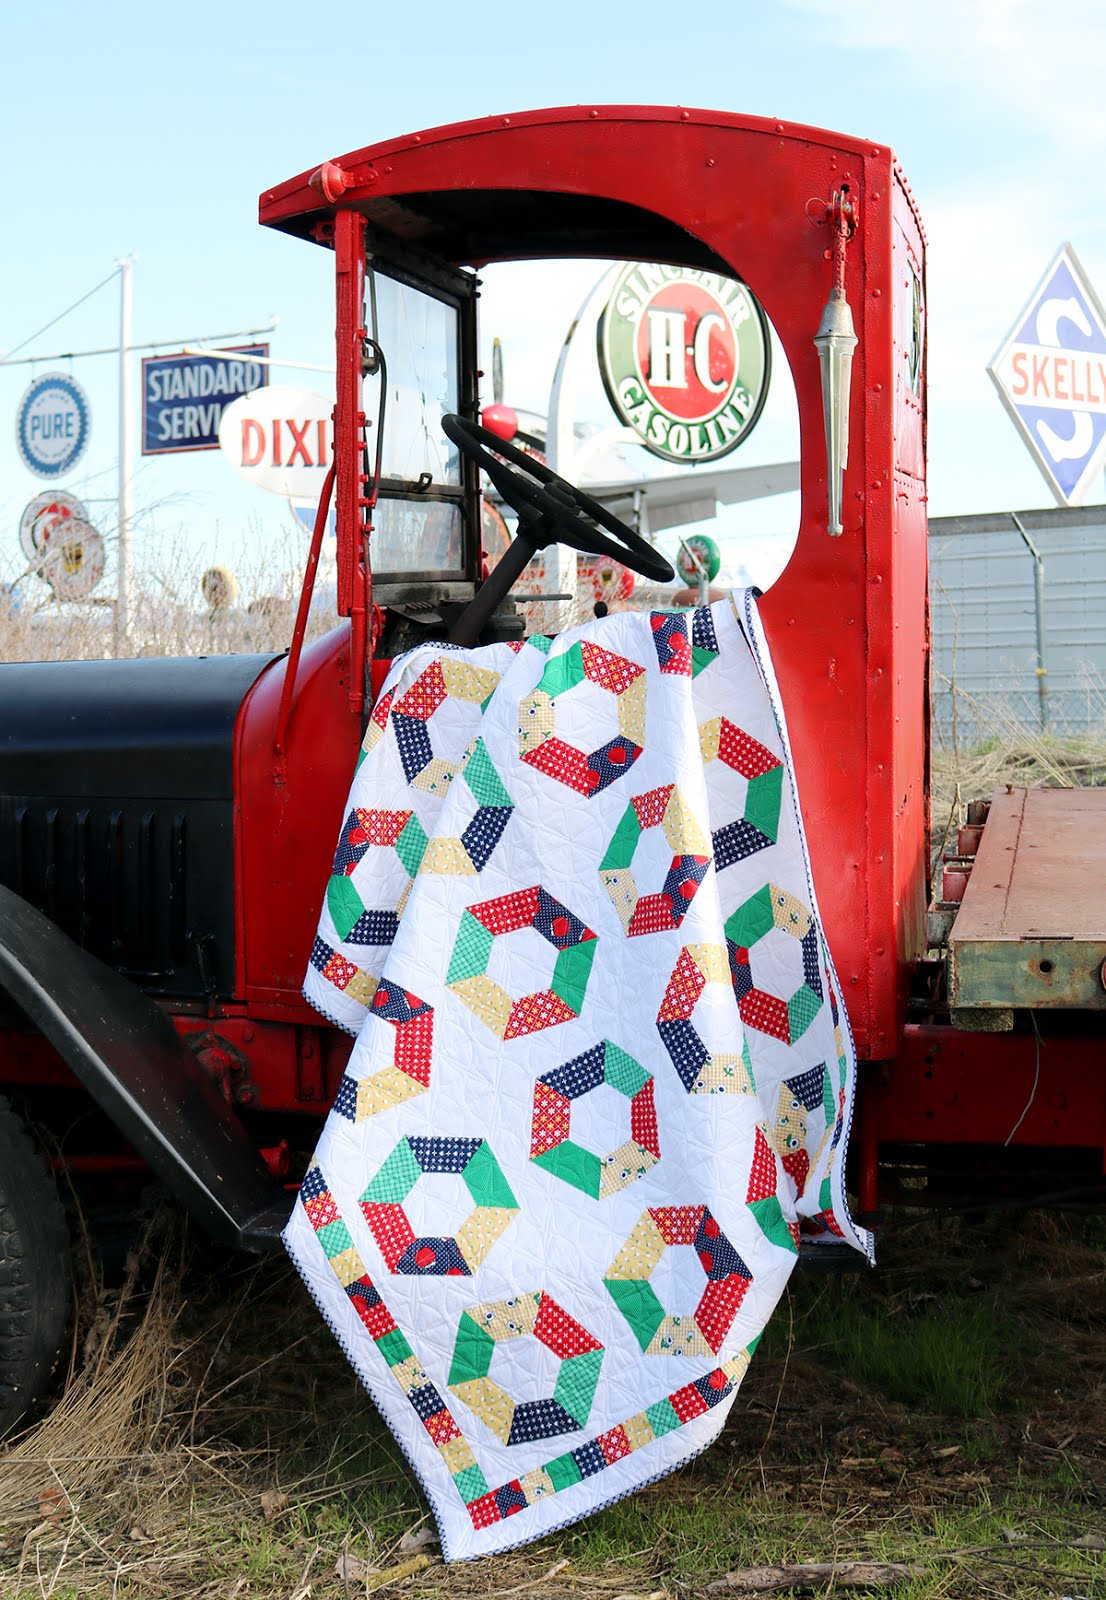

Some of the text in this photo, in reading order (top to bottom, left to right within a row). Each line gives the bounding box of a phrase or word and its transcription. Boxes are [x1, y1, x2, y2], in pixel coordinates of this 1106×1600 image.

[149, 361, 261, 402] STANDARD
[31, 412, 74, 441] PURE
[158, 402, 229, 441] SERVI
[618, 376, 754, 455] GASOLINE
[241, 418, 327, 467] DIXI
